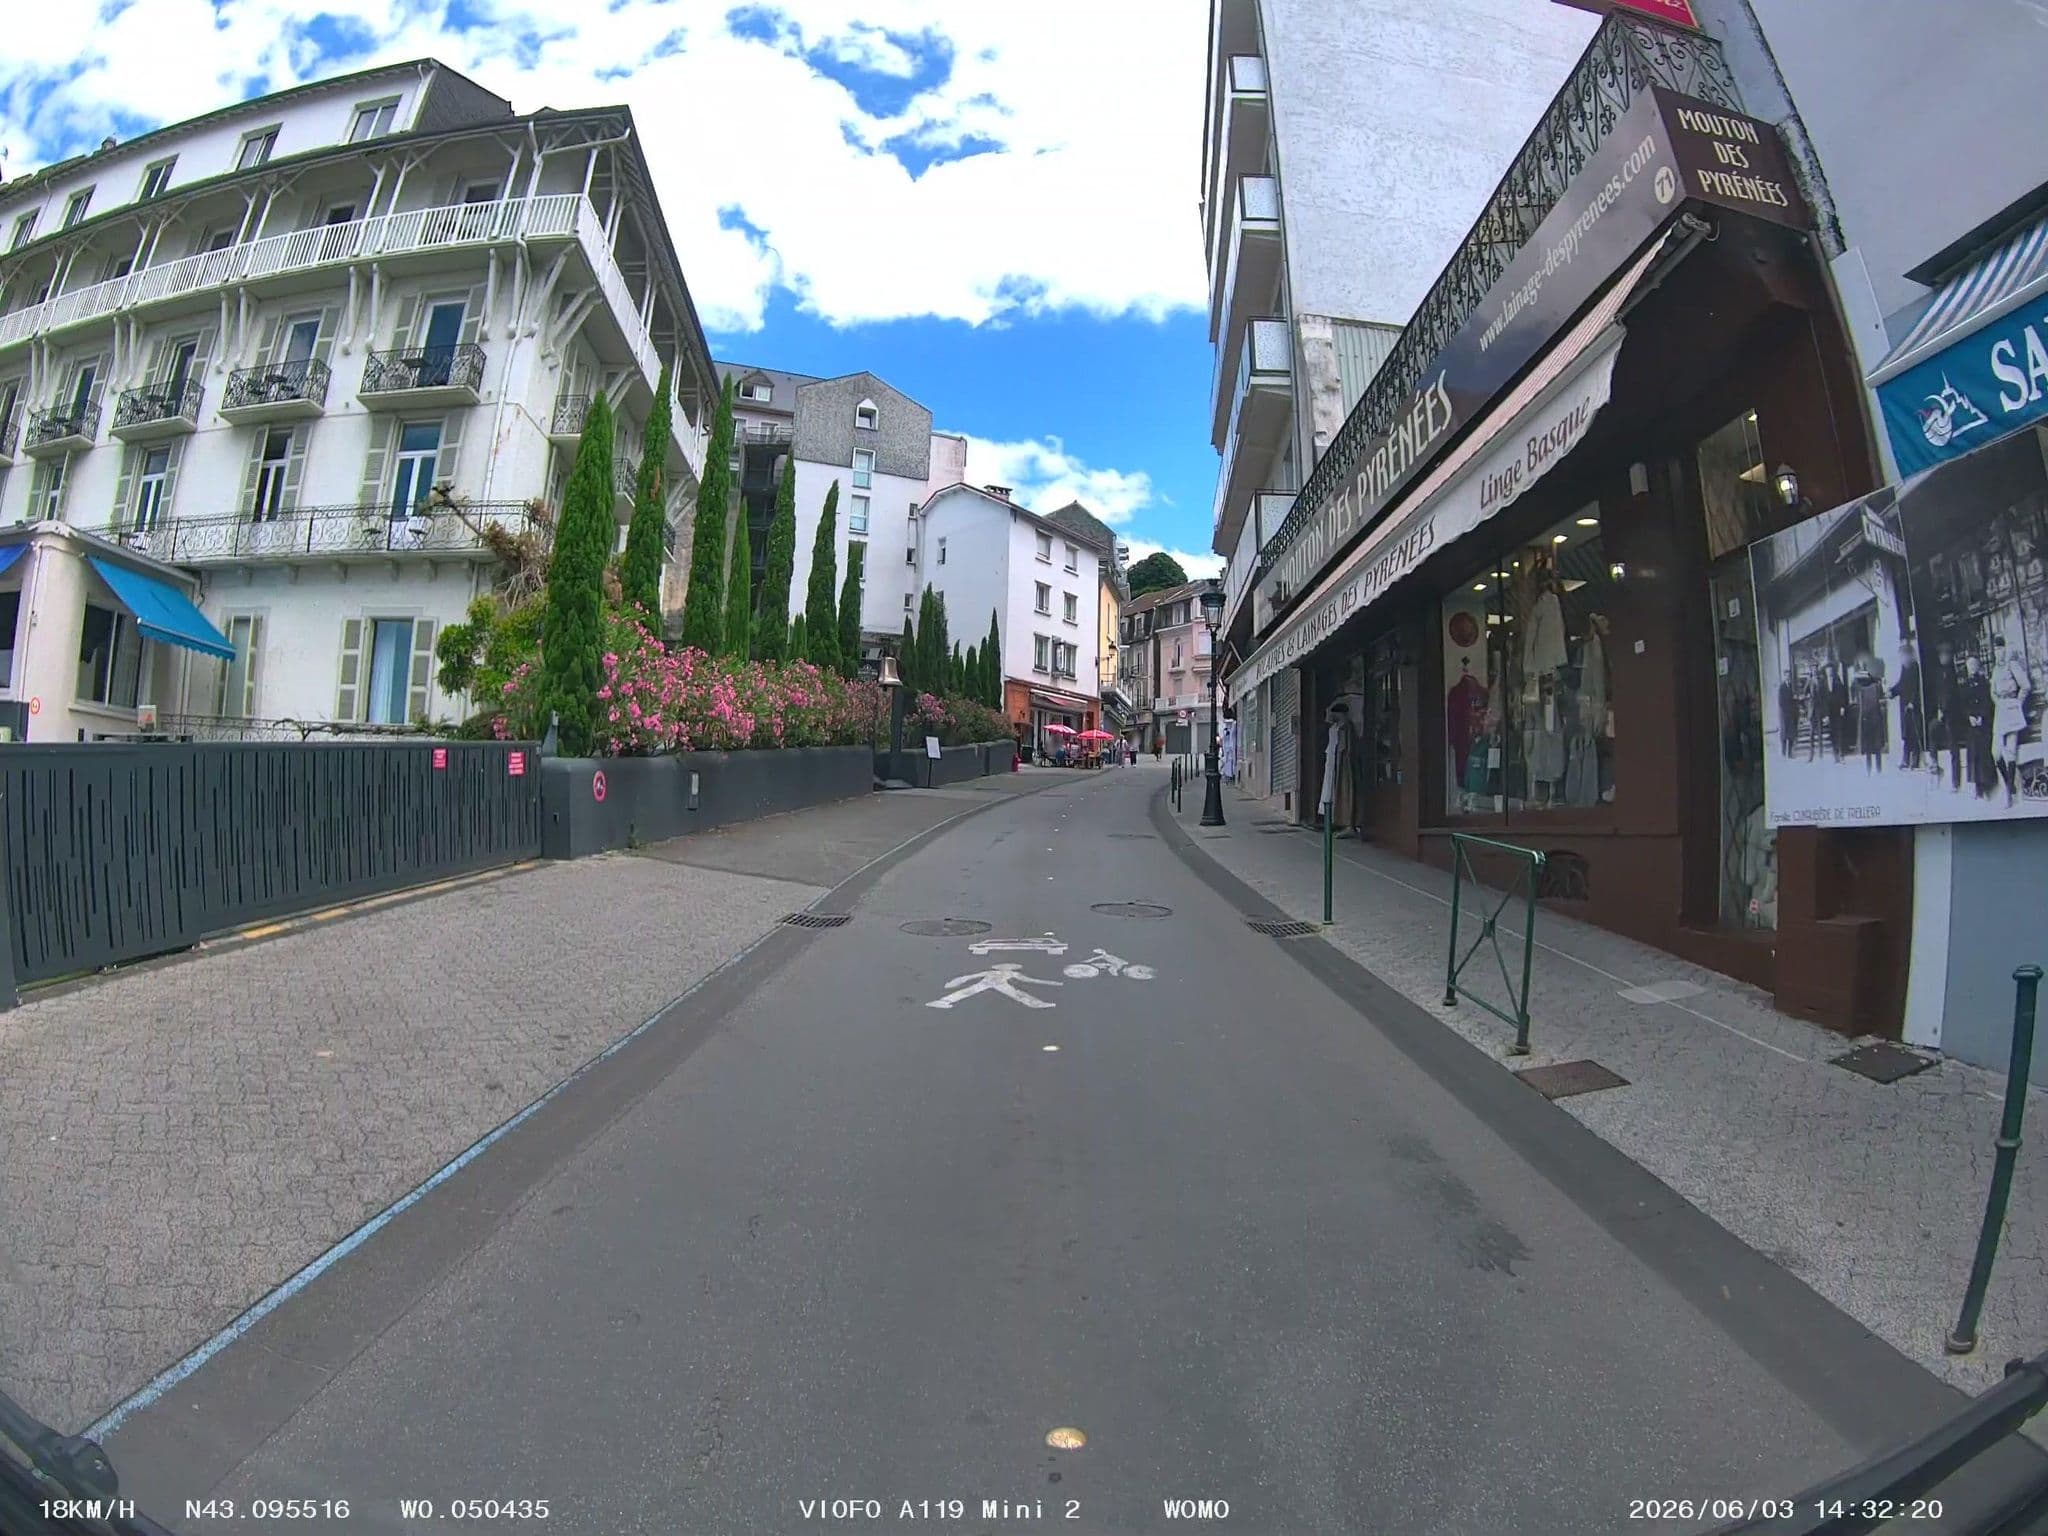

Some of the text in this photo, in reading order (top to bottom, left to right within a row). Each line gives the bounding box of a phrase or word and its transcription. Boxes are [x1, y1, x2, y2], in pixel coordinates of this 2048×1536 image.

[1676, 107, 1760, 145] MOUTON
[1713, 141, 1749, 169] DES
[1656, 170, 1674, 198] 71
[1697, 169, 1789, 207] PYRÉNÉES
[1479, 134, 1657, 352] www.lainage-despyrenees.com
[1991, 316, 2048, 412] SA
[1280, 368, 1453, 601] MOUTON DES PYRÉNÉES
[1296, 602, 1338, 650] LAINAGES
[1341, 581, 1358, 616] DES
[1363, 514, 1436, 599] PYRÉNÉES
[1480, 458, 1523, 510] Linge
[1526, 395, 1591, 473] Basque
